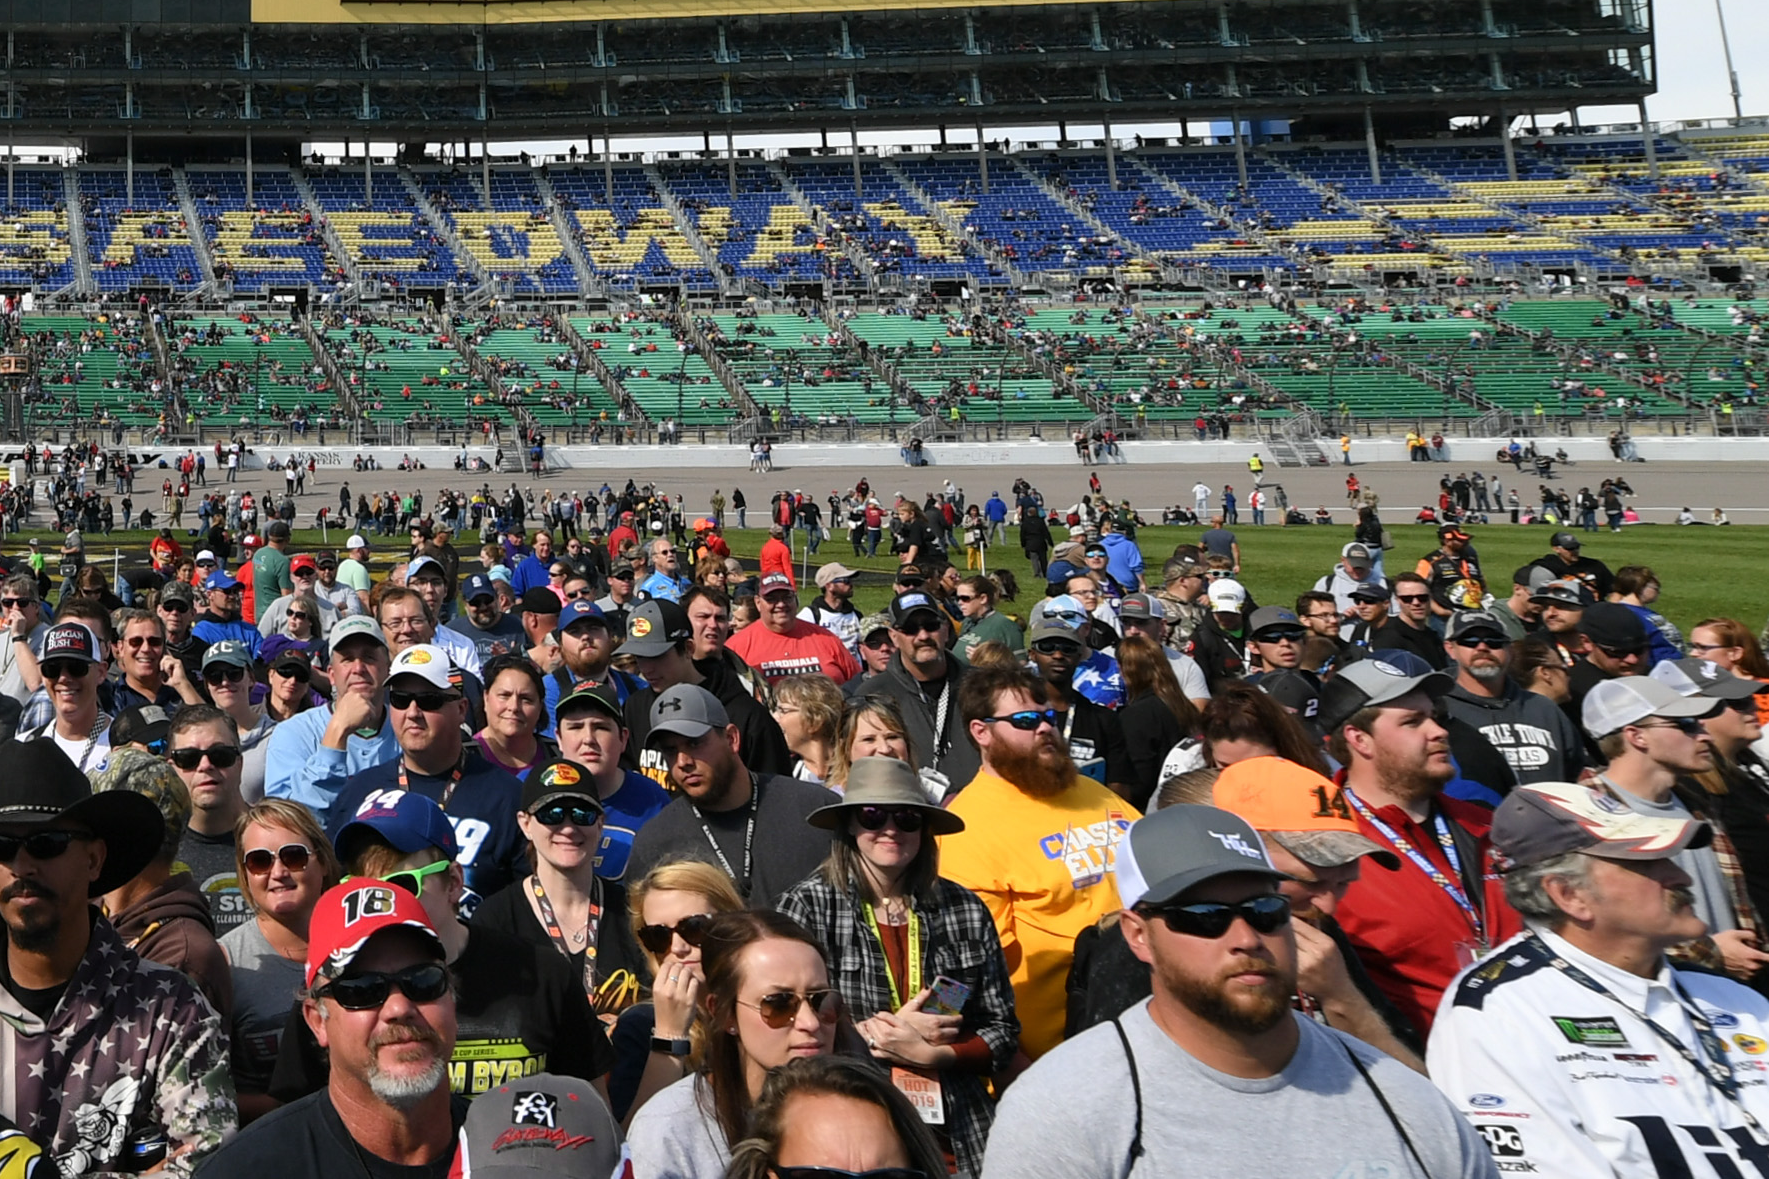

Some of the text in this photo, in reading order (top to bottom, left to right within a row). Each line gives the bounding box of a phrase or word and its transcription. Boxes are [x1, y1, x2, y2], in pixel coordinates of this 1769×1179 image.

[49, 630, 84, 641] REAGAN
[47, 639, 71, 651] BUSH
[207, 641, 234, 658] KC
[761, 657, 820, 669] CARDINALS
[1107, 673, 1120, 686] 4
[1304, 698, 1319, 717] 2
[1514, 723, 1558, 751] TOWN
[356, 788, 406, 817] 24
[1312, 785, 1353, 820] 14
[447, 816, 491, 866] 9
[1039, 819, 1124, 860] CHASE
[341, 887, 396, 929] 18
[458, 1048, 472, 1056] CUP
[903, 1079, 930, 1092] HOT
[910, 1094, 936, 1108] 019
[1496, 1160, 1540, 1173] azak
